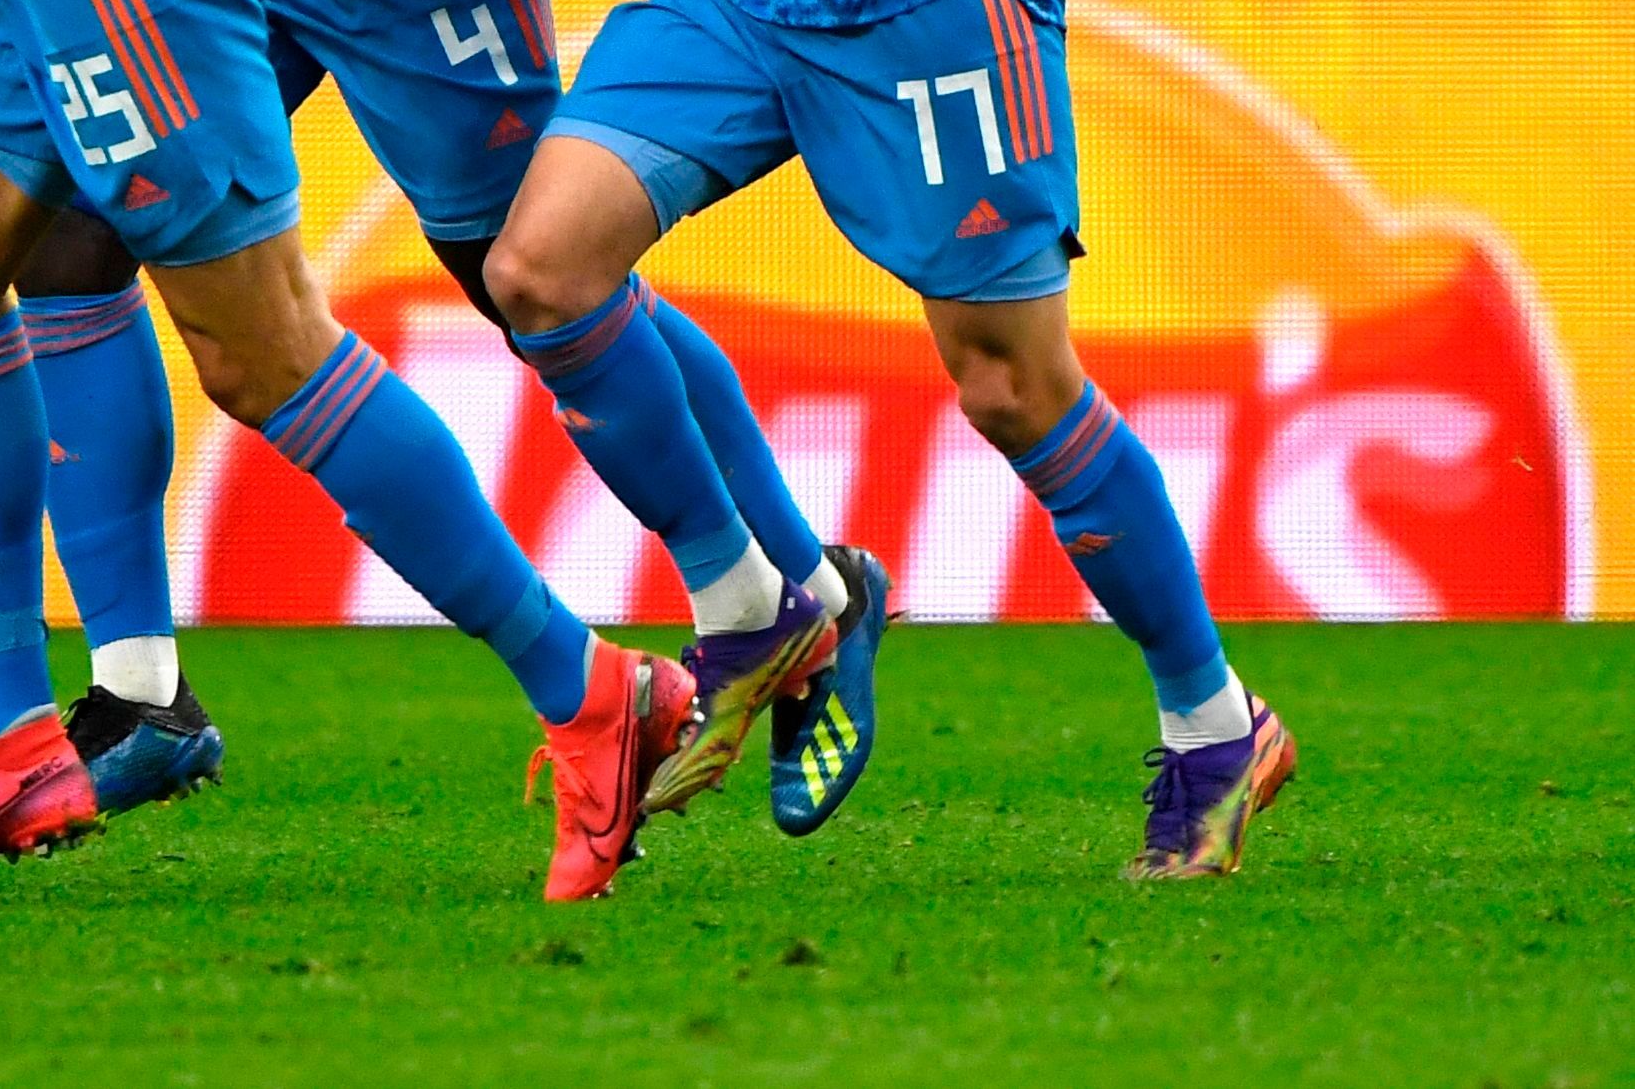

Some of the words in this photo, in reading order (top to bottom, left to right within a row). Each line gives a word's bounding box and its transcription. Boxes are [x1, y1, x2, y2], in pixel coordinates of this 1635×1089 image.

[429, 2, 519, 87] 4
[48, 52, 158, 166] 25
[896, 67, 1007, 186] 17
